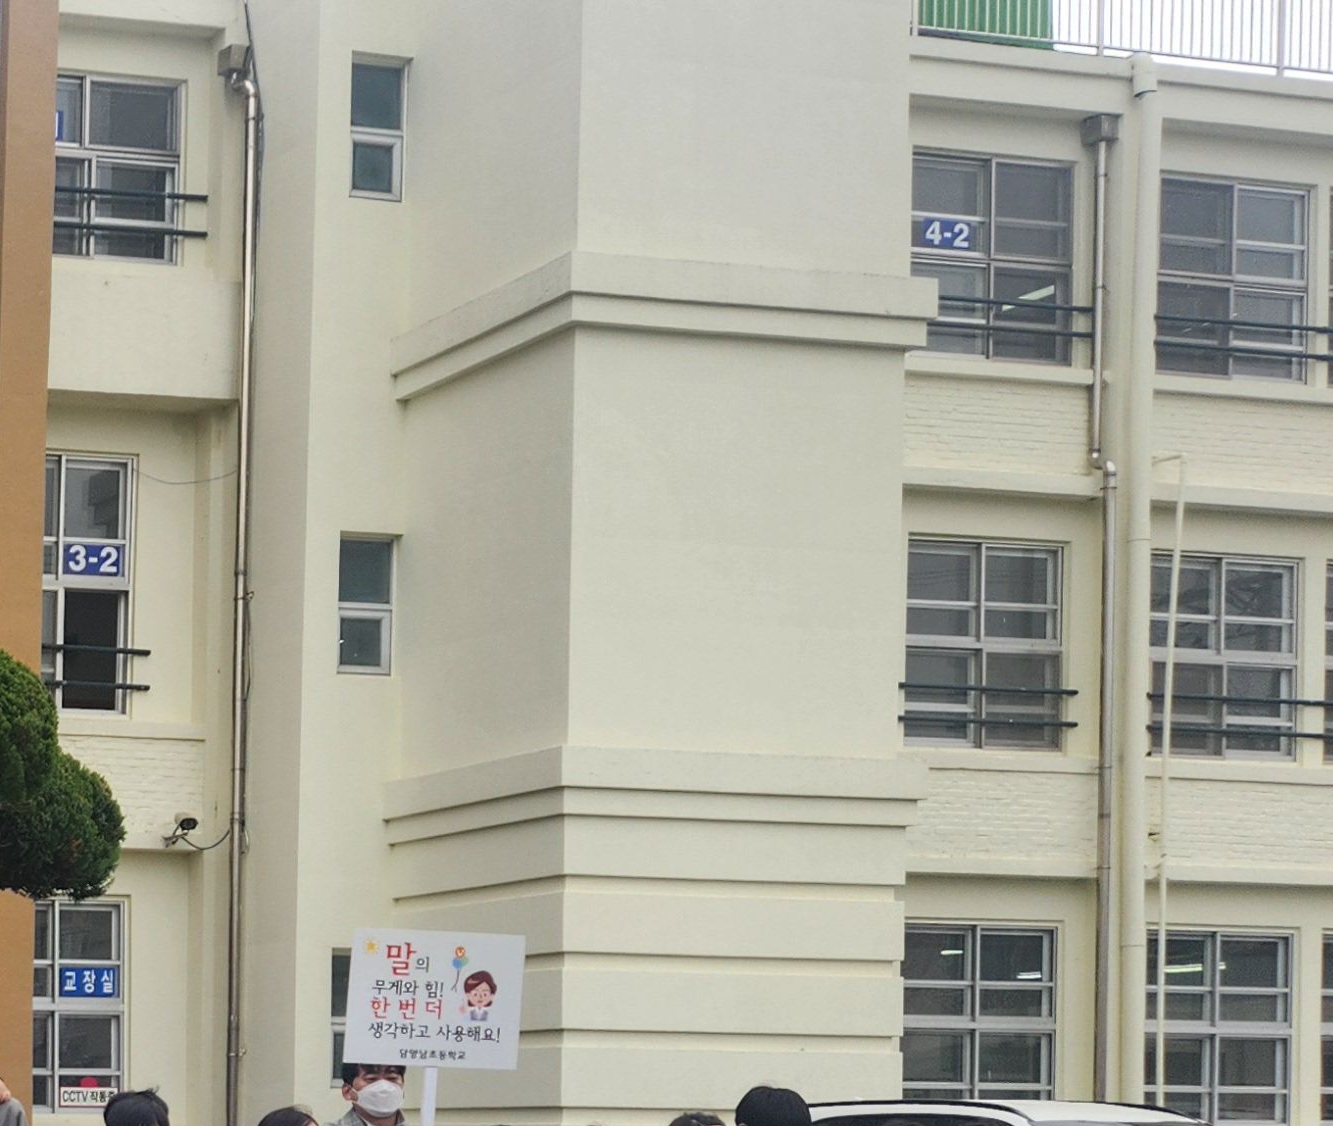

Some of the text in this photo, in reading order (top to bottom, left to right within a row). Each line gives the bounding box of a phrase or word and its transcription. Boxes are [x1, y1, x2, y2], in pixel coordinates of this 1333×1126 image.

[925, 221, 969, 248] 4-2
[68, 544, 118, 573] 3-2
[386, 942, 430, 976] 말의
[64, 970, 114, 993] 교장실
[372, 979, 444, 998] 무게와 힘!
[371, 997, 442, 1020] 한 번 더
[368, 1022, 501, 1044] 생각하고 사용해요!
[62, 1090, 90, 1103] CCTV
